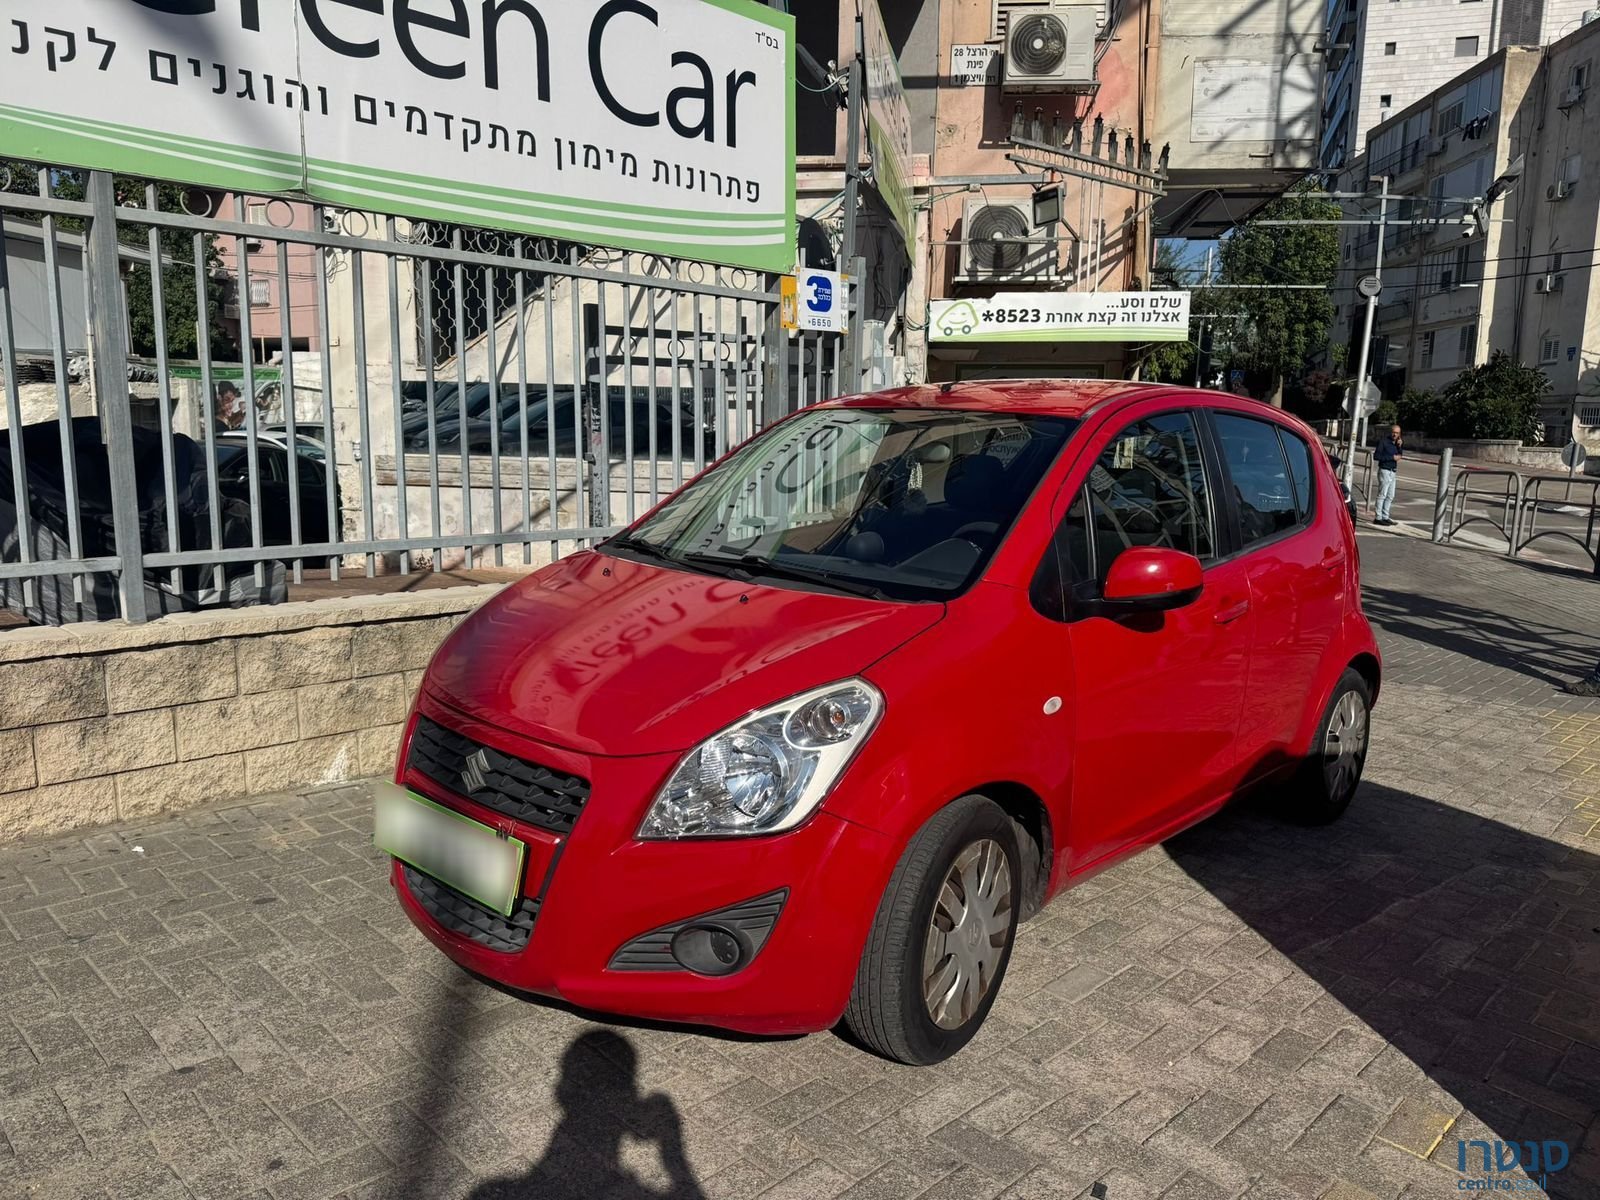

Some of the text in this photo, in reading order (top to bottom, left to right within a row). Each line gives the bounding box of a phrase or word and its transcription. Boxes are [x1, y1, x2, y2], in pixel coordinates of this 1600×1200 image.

[755, 31, 779, 49] בס"ד
[954, 48, 964, 57] 28
[966, 46, 988, 56] הרצל
[966, 60, 984, 69] פינת
[588, 0, 757, 148] Car
[148, 48, 328, 116] והוגנים
[354, 93, 537, 158] מתקדמים
[554, 137, 638, 178] מימון
[652, 159, 760, 203] פתרונות
[1106, 296, 1182, 308] שלם וסע...
[1045, 312, 1084, 323] אחרת
[1087, 312, 1117, 325] קצת
[1121, 312, 1138, 322] זה
[1142, 310, 1181, 322] אצלנו
